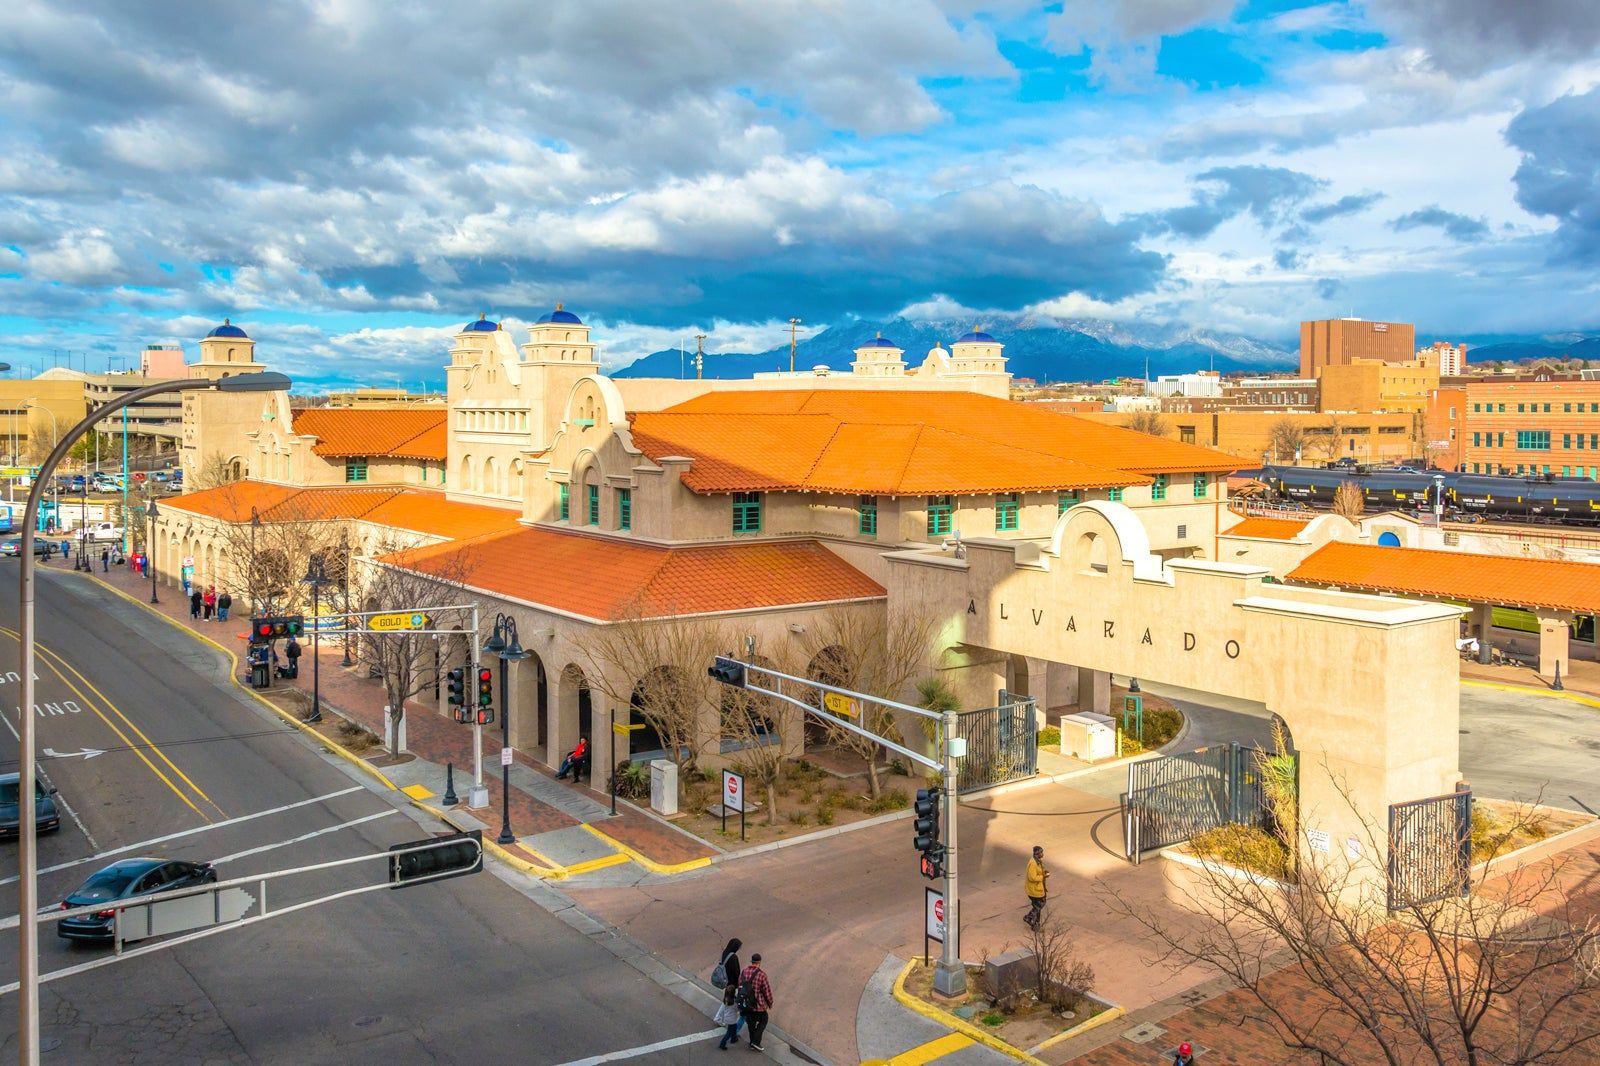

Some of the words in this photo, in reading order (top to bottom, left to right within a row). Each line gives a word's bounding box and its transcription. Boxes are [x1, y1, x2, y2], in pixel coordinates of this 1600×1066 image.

[379, 617, 402, 627] GOLD
[967, 597, 1241, 660] ALVARADO
[16, 701, 82, 720] ONL
